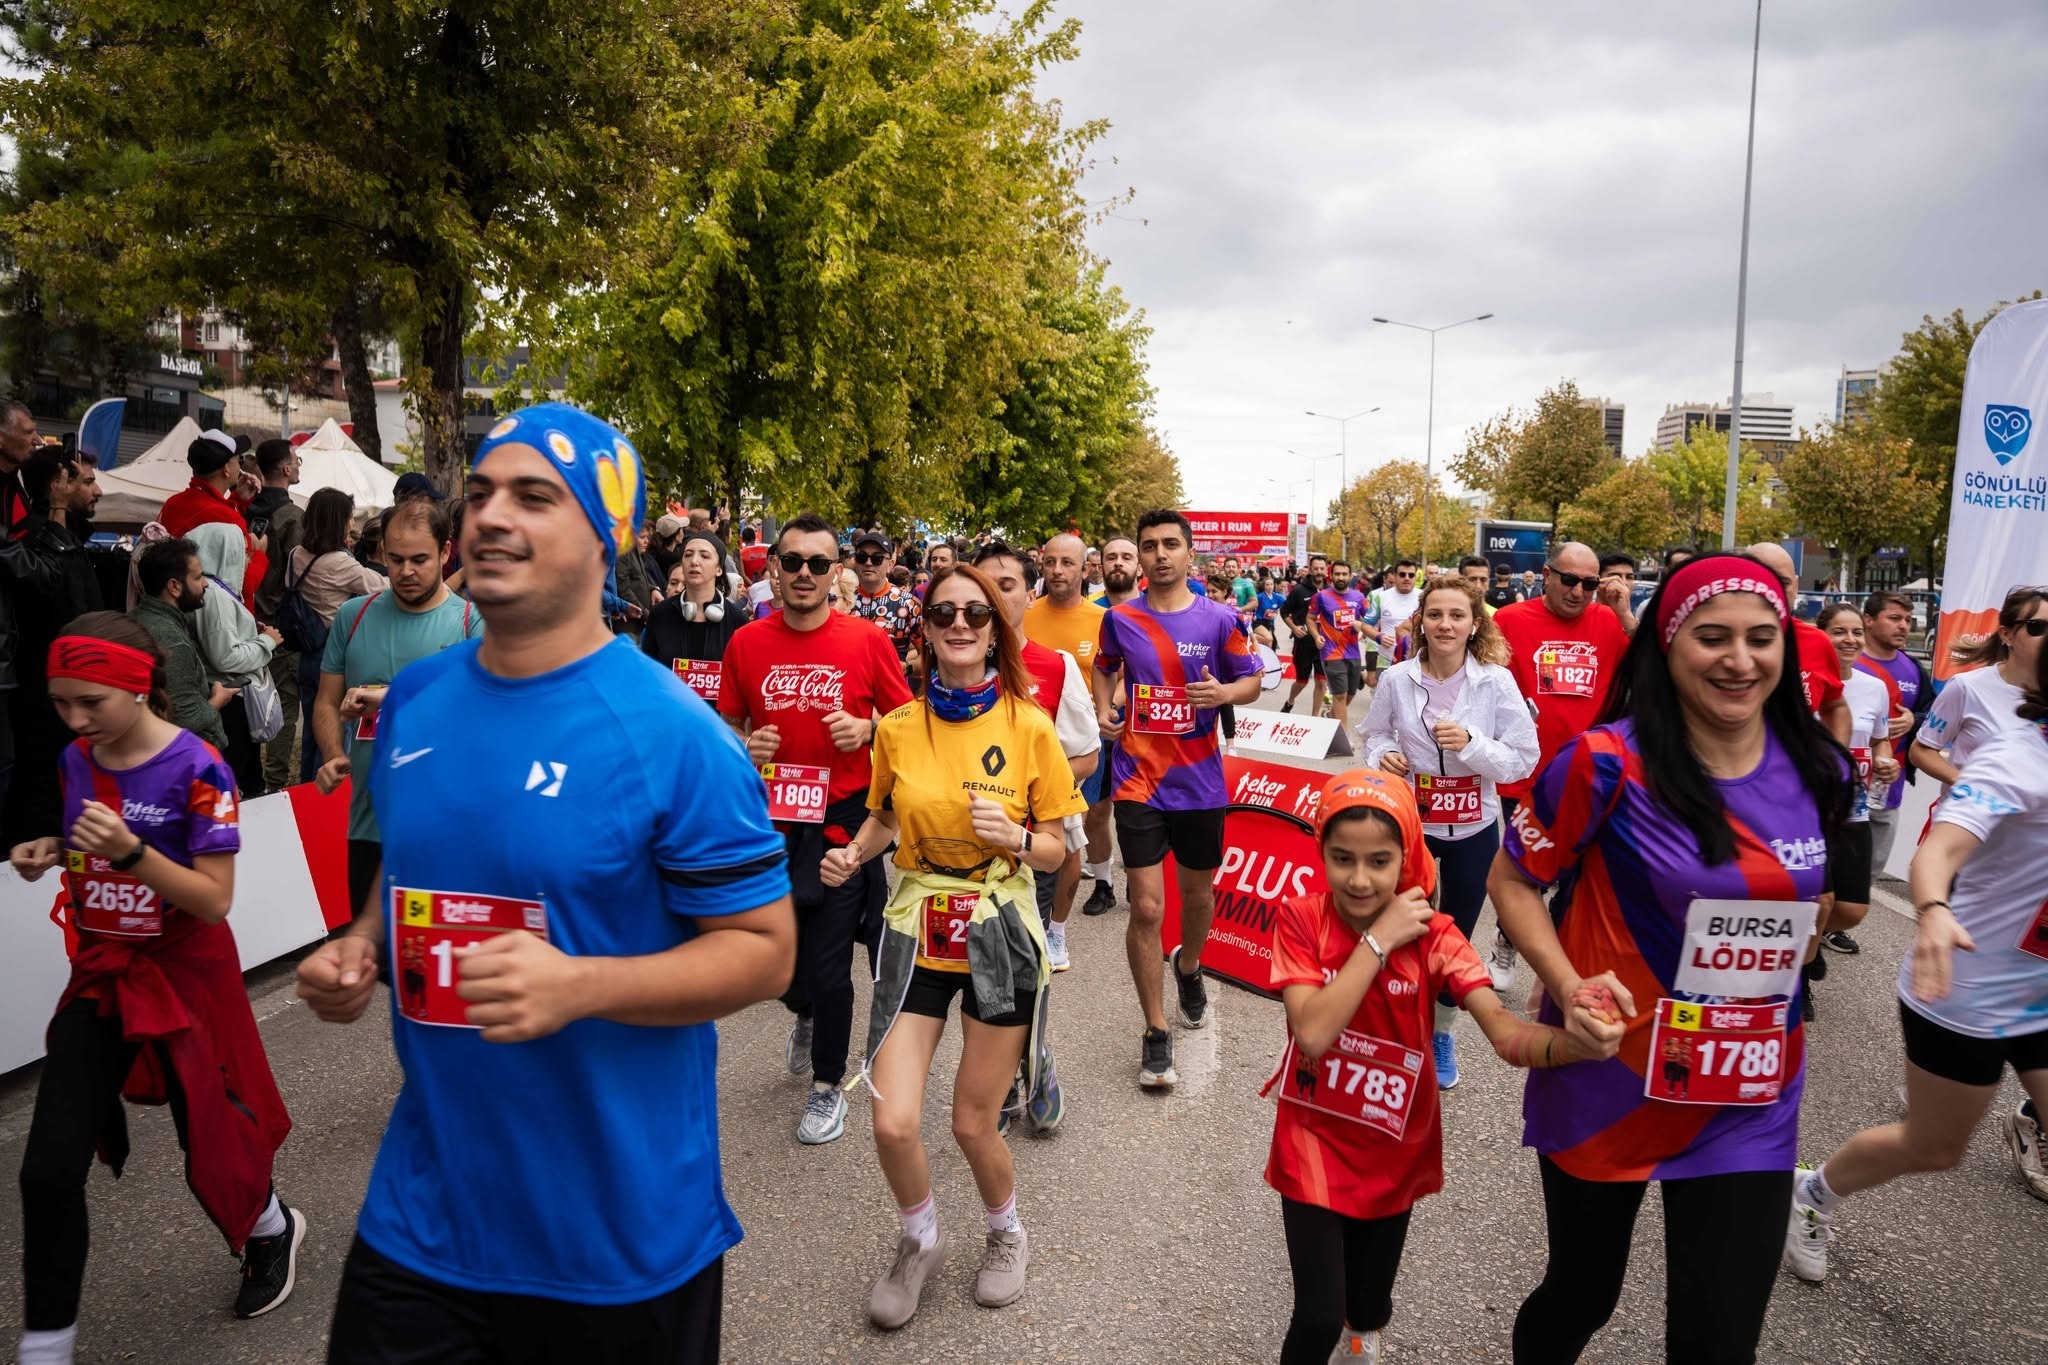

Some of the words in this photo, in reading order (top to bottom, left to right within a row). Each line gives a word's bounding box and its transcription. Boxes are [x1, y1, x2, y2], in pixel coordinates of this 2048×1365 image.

[161, 354, 203, 376] BAŞROL
[1965, 470, 2047, 494] GÖNÜLLÜ
[1963, 489, 2046, 512] HAREKETİ
[1227, 522, 1252, 532] RUN
[687, 673, 721, 689] 2592
[1555, 667, 1594, 685] 1827
[1150, 702, 1191, 721] 3241
[1281, 735, 1302, 747] RUN
[773, 783, 823, 808] 1809
[962, 781, 1016, 798] RENAULT
[1431, 791, 1478, 811] 2876
[1213, 846, 1315, 903] PLUS
[84, 880, 155, 913] 2652
[1707, 916, 1794, 939] BURSA
[1207, 928, 1273, 961] plustiming.co
[1692, 942, 1798, 971] LÖDER
[1696, 1039, 1780, 1077] 1788
[1325, 1058, 1407, 1110] 1783
